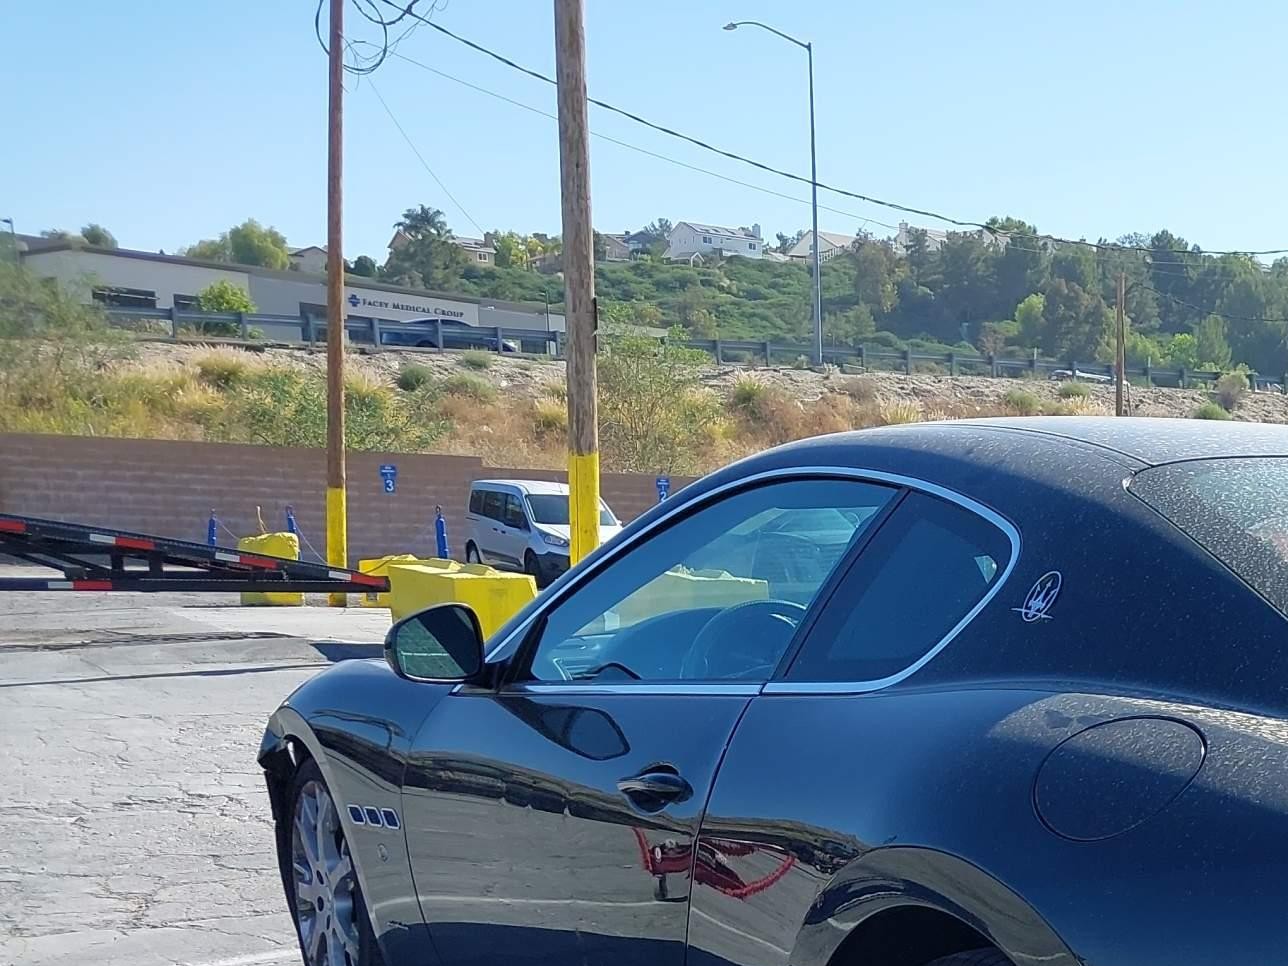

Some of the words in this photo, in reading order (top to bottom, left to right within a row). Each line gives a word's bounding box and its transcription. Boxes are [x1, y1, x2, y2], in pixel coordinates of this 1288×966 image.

[362, 299, 389, 309] FACEY
[392, 302, 432, 314] MEDICAL
[434, 307, 464, 318] GROUP
[386, 479, 394, 492] 3
